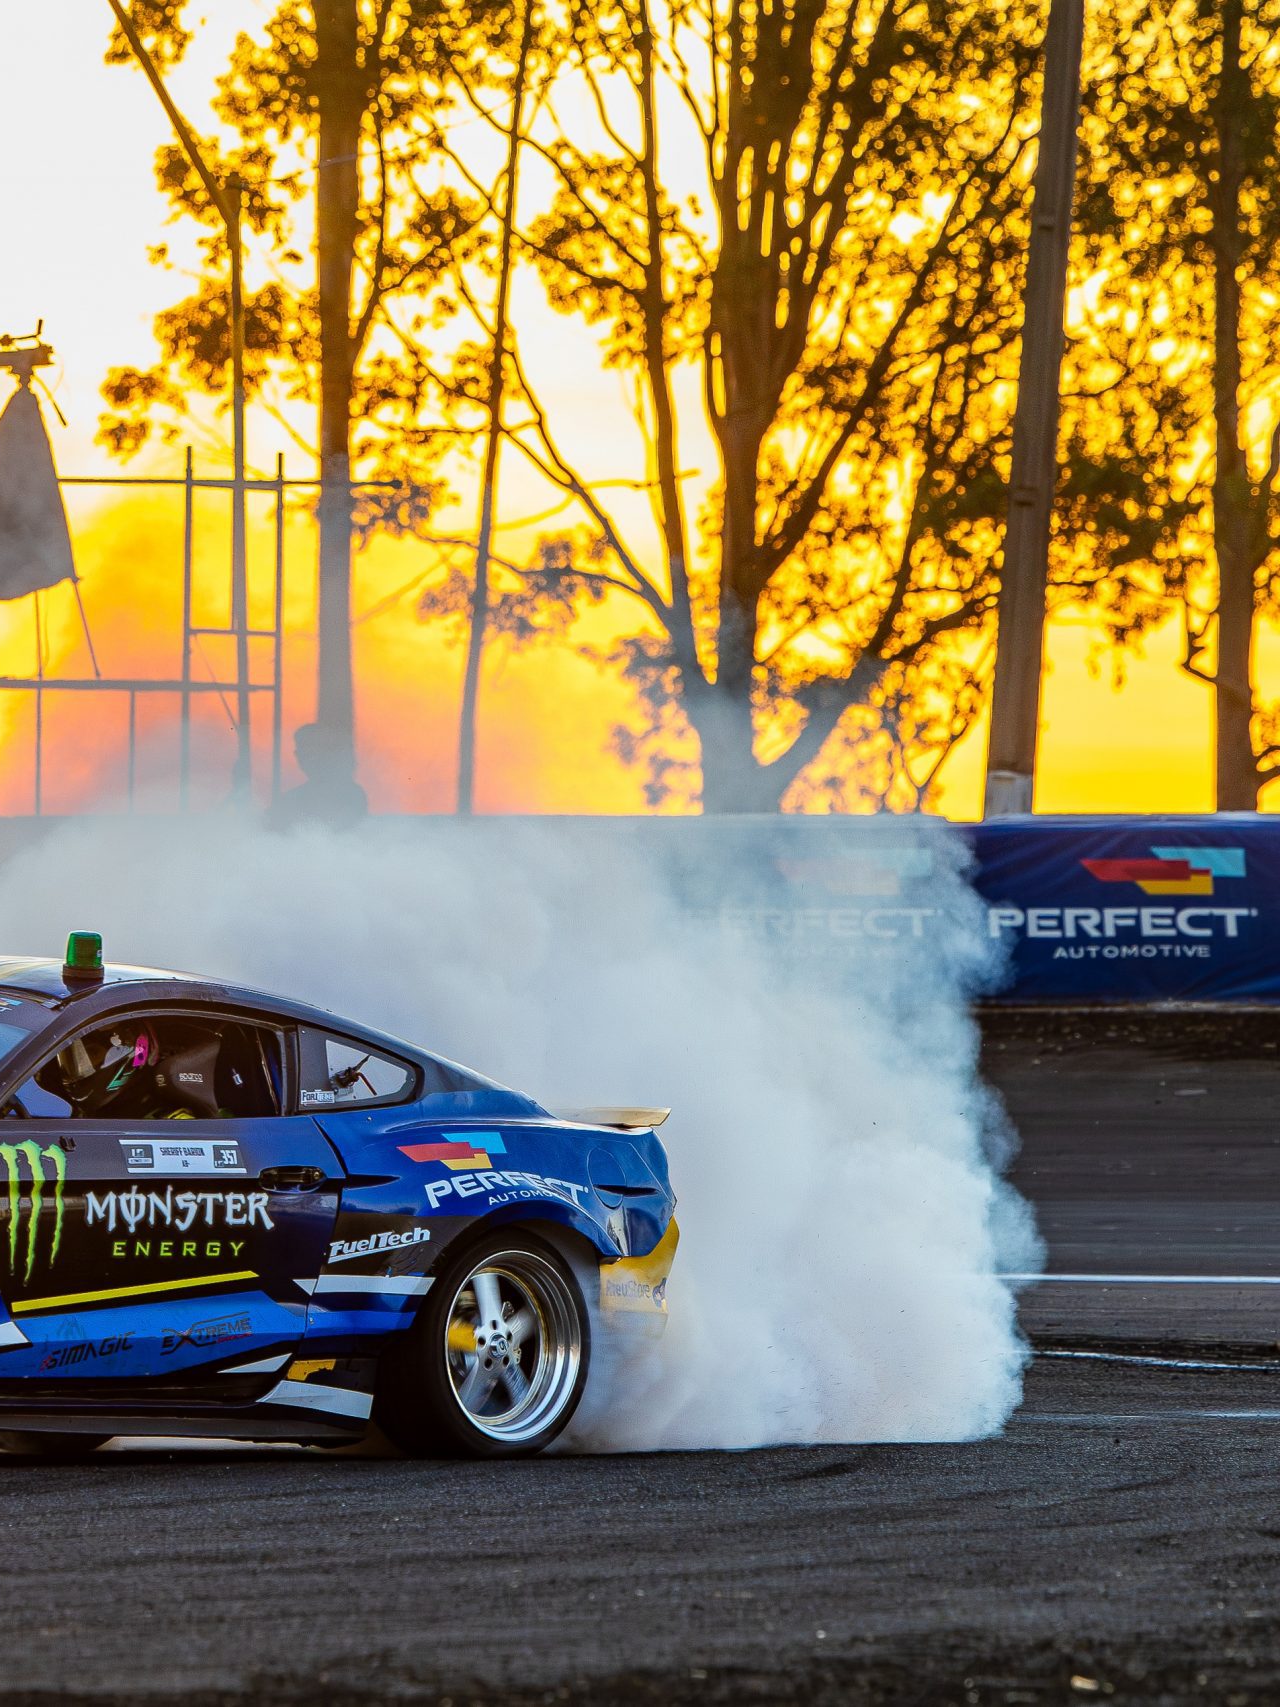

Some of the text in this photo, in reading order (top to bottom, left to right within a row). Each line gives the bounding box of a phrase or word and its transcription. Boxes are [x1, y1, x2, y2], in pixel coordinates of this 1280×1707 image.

[720, 908, 942, 937] ERFECT
[988, 907, 1258, 938] PERFECT
[1053, 944, 1211, 959] AUTOMOTIVE
[220, 1150, 238, 1165] 357
[424, 1171, 588, 1209] PERFECT
[488, 1190, 554, 1206] AUTOMO
[113, 1242, 244, 1256] ENERGY
[329, 1227, 431, 1258] FuelTech
[47, 1331, 136, 1371] SIMAGIC
